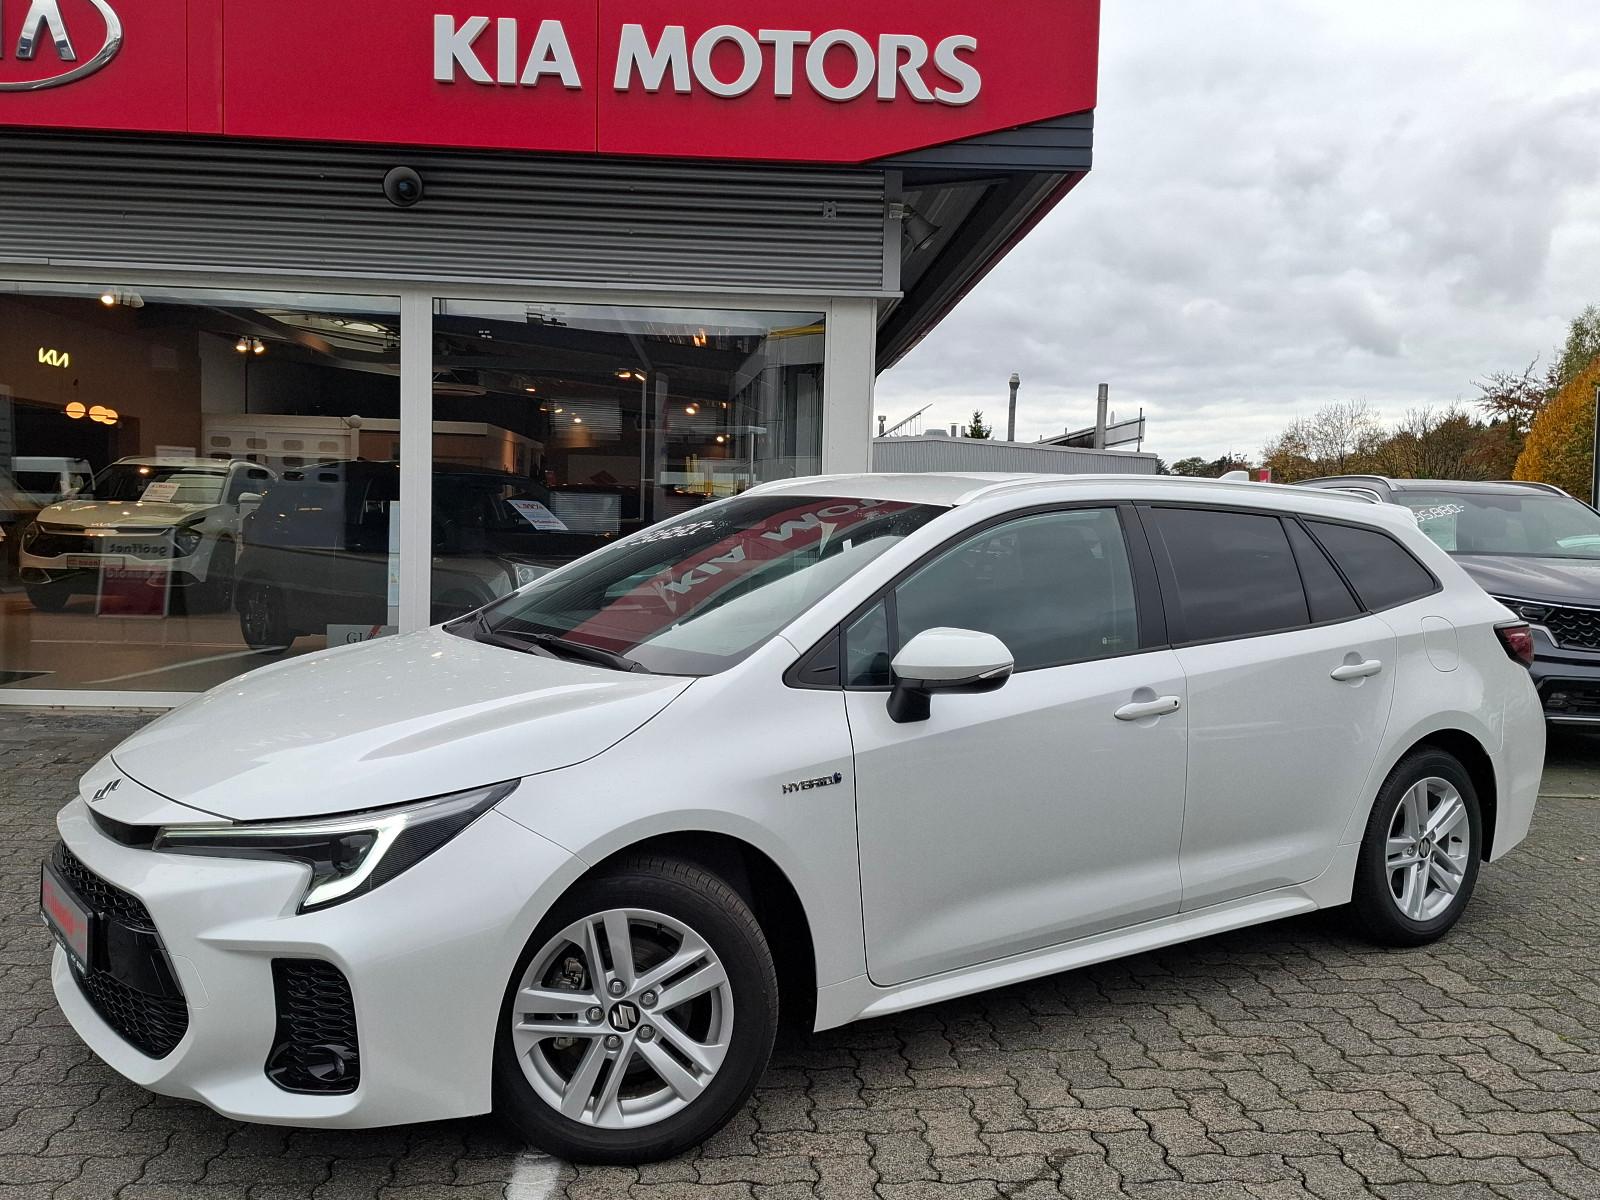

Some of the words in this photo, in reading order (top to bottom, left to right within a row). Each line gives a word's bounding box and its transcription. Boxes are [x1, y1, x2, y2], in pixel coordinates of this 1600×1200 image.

[434, 14, 582, 89] KIA
[614, 24, 981, 106] MOTORS
[782, 776, 835, 795] HYBRID
